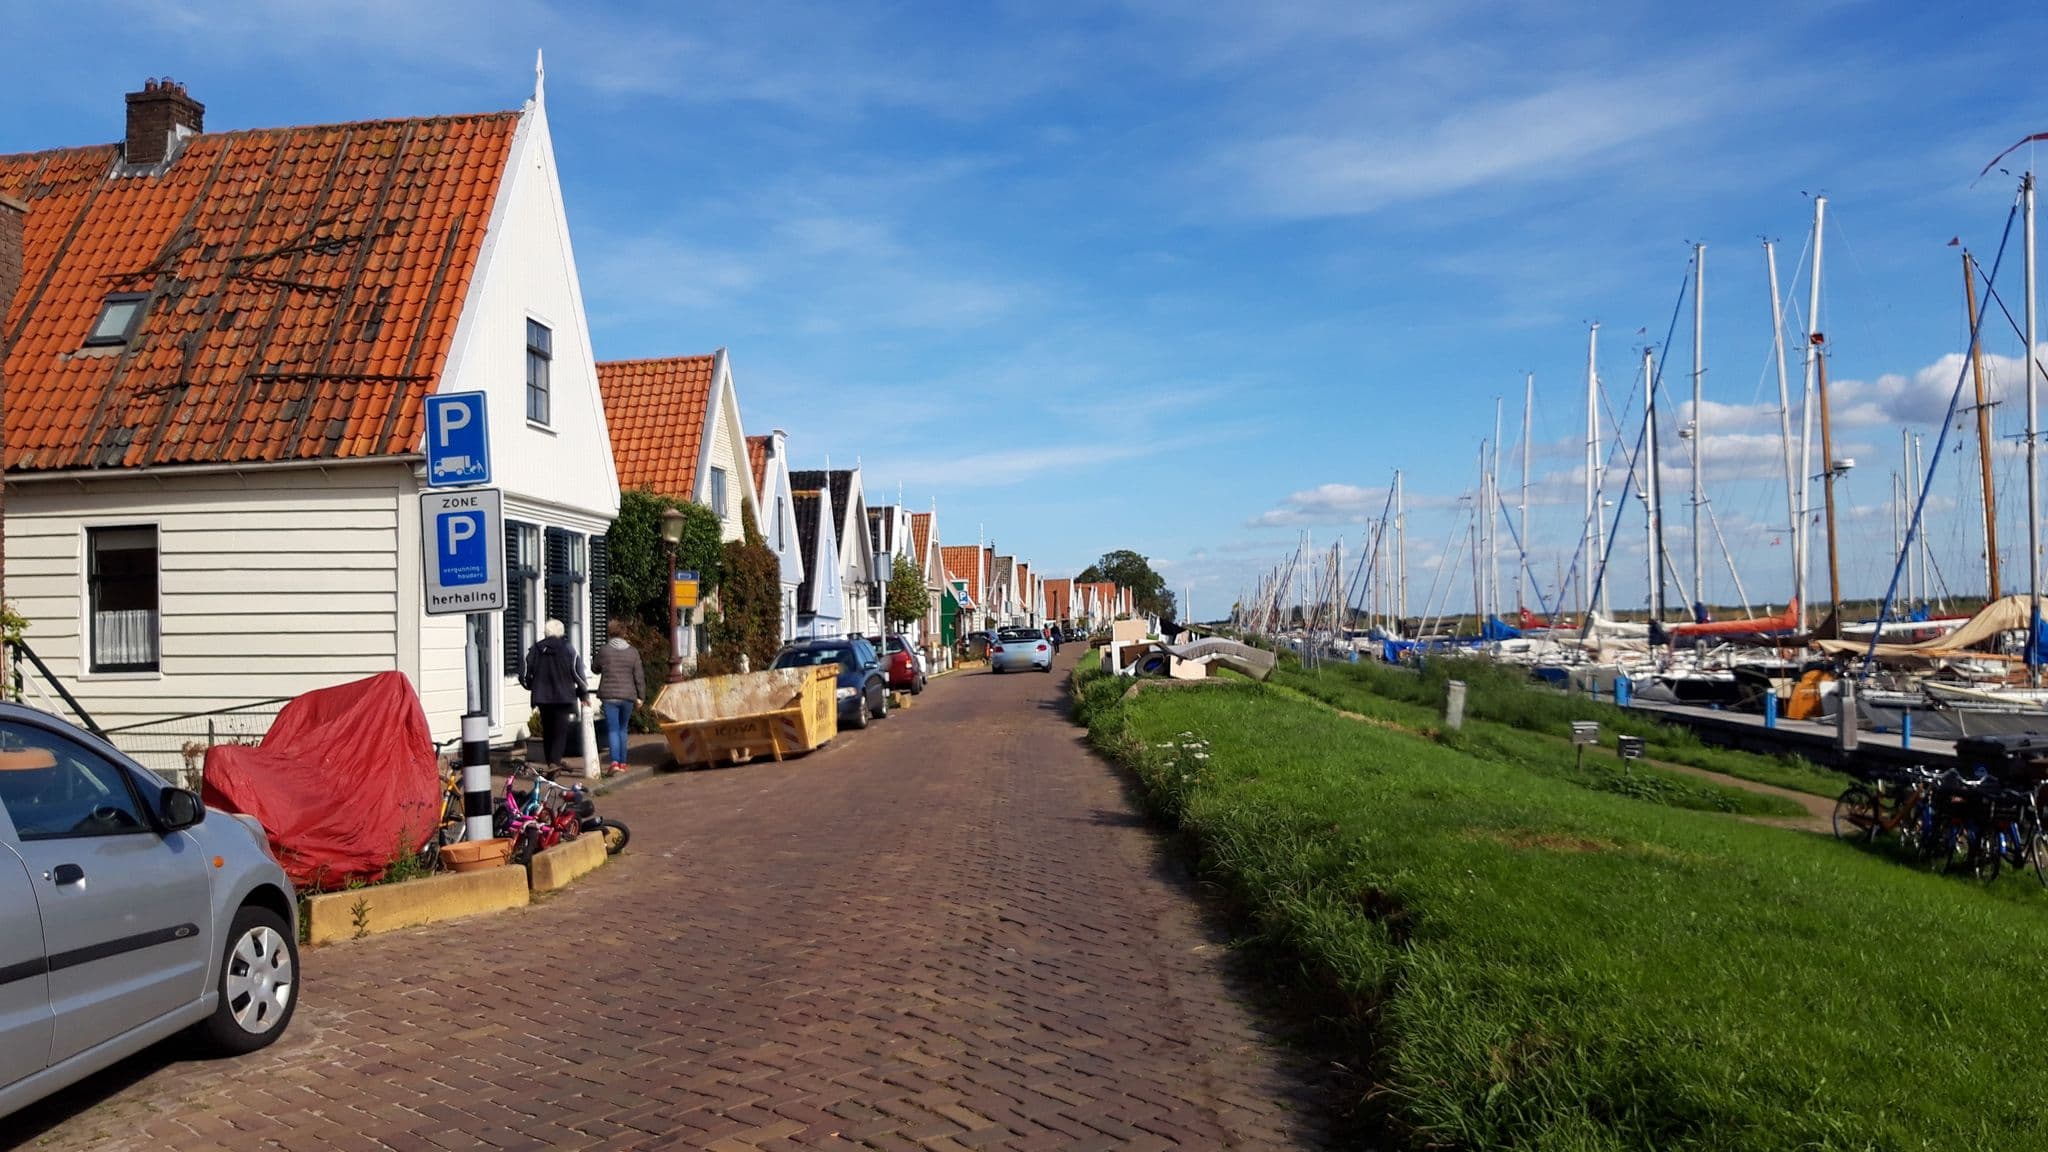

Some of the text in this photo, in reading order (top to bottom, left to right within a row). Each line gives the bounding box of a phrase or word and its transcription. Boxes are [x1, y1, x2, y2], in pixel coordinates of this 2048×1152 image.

[439, 401, 472, 447] P
[442, 496, 478, 509] ZONE
[448, 515, 477, 555] P
[432, 591, 496, 605] herhaling
